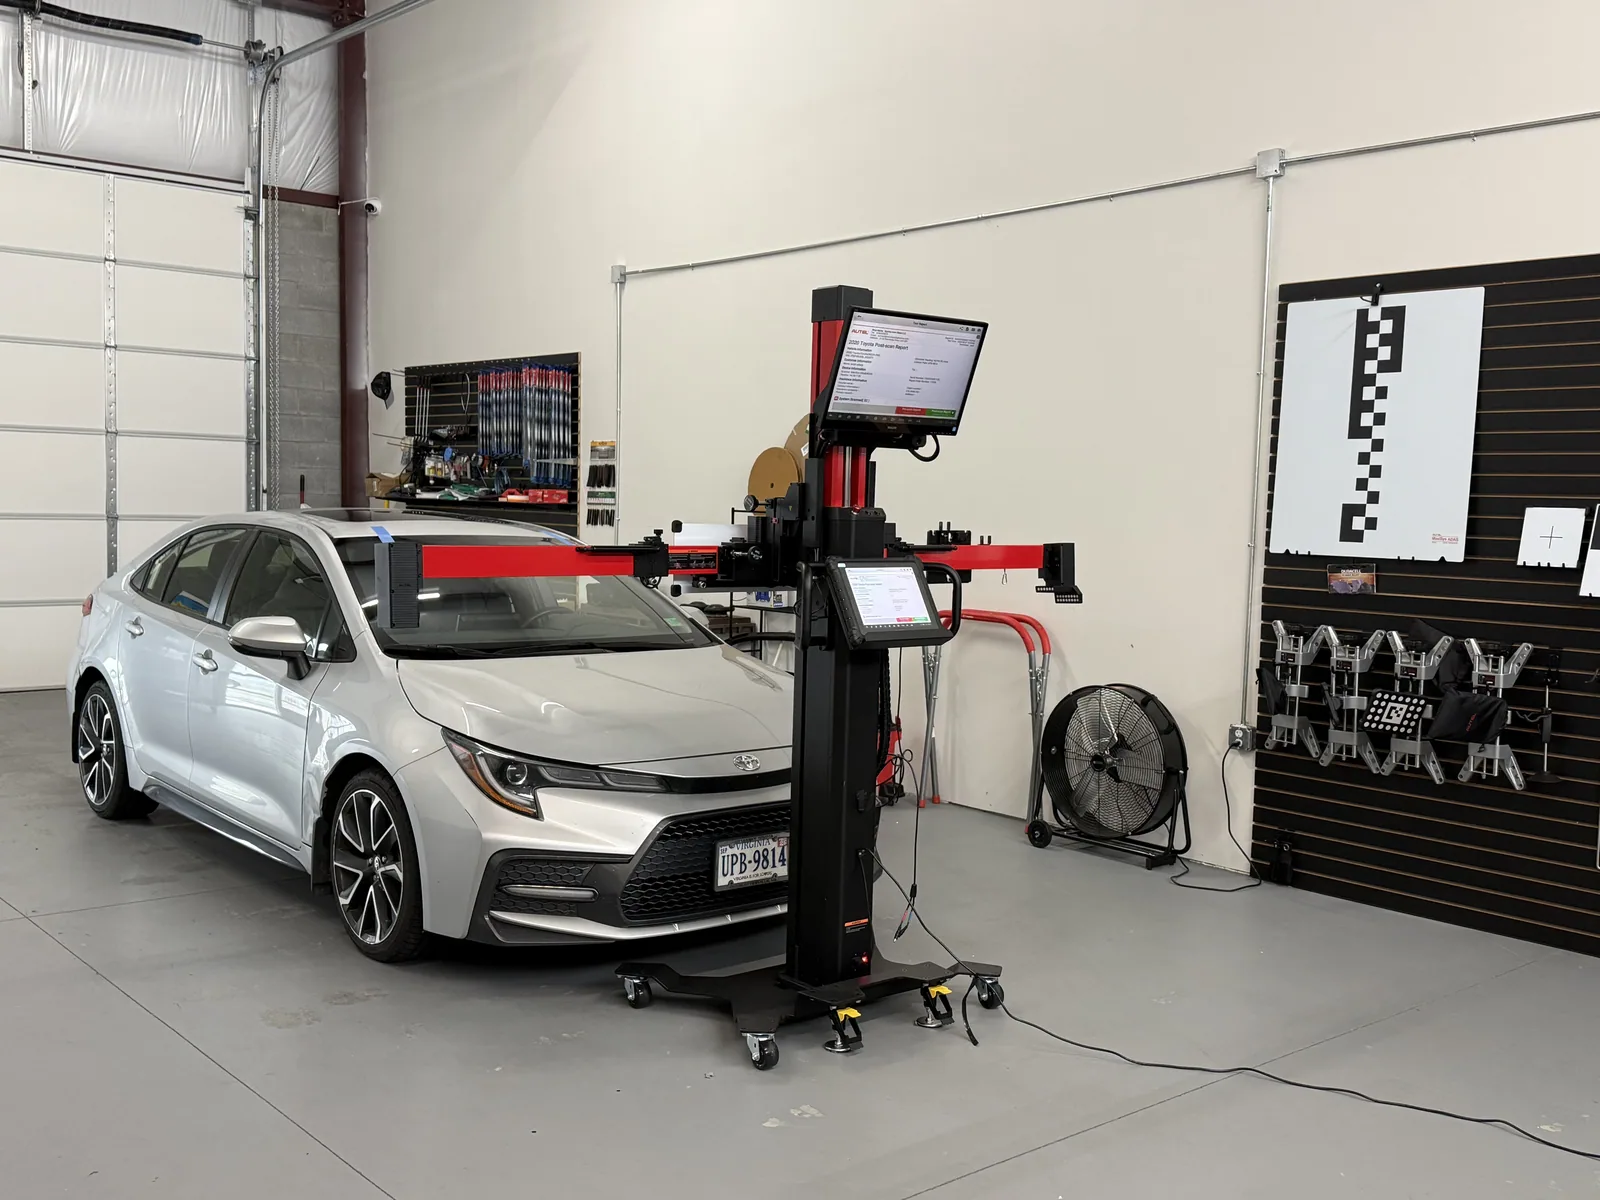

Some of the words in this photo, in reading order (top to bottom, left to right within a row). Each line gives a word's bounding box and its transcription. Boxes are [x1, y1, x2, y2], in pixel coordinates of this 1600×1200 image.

[720, 847, 728, 855] SEP
[736, 839, 771, 851] VIRGINIA
[721, 846, 787, 878] UPB-9814
